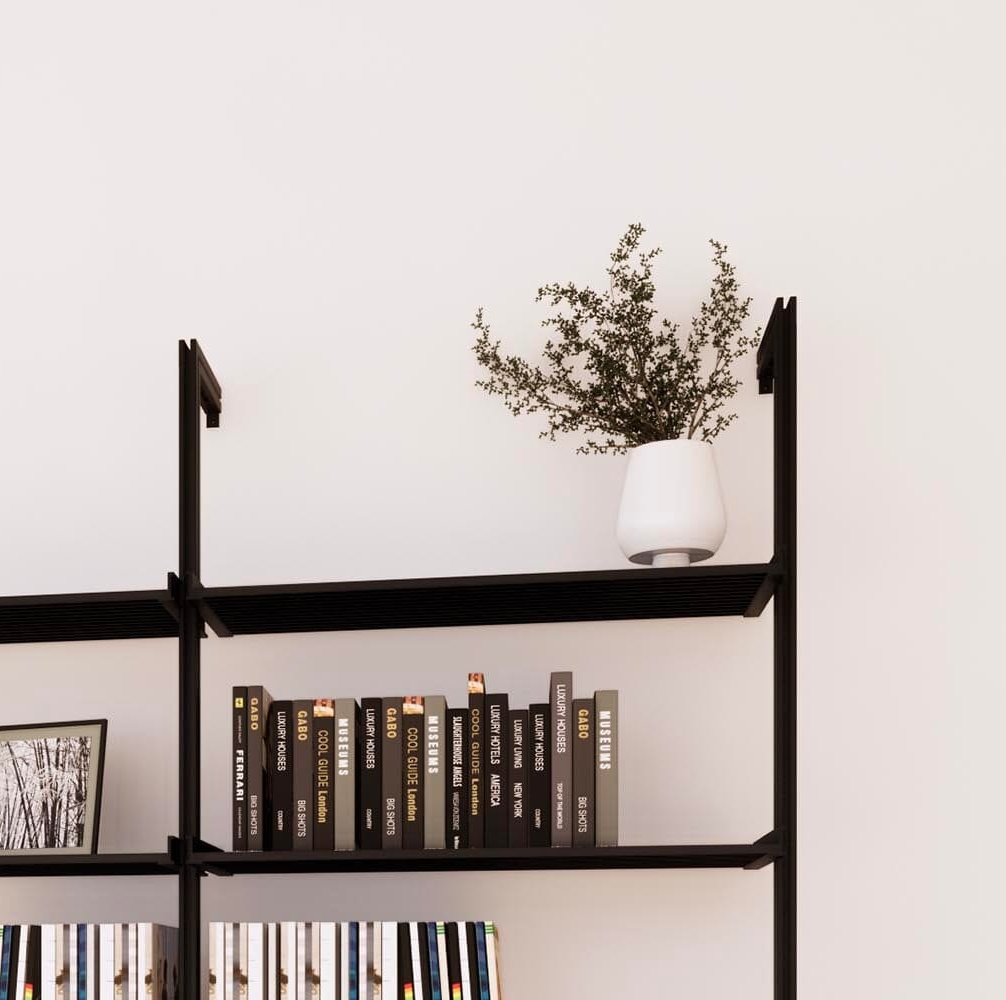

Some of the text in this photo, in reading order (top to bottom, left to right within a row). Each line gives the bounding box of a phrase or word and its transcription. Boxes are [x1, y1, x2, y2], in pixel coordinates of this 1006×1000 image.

[250, 698, 258, 730] GABO
[277, 711, 286, 771] LUXURY HOUSES
[298, 710, 307, 740] GABO
[366, 708, 375, 769] LUXURY HOUSES
[387, 707, 397, 738] GABO
[453, 716, 462, 764] SLAUGHTERHOUSE
[535, 714, 544, 771] LUXURY HOUSES
[557, 684, 566, 753] LUXURY HOUSES
[578, 709, 589, 739] GABO
[600, 711, 611, 769] MUSEUMS
[338, 718, 348, 775] MUSEUMS
[428, 716, 438, 774] MUSEUMS
[472, 708, 480, 815] COOL GUIDE London
[491, 705, 500, 807] LUXURY HOTELS AMERICA
[514, 720, 522, 818] LUXURY LIVING NEW YORK
[236, 750, 244, 800] FERRARI
[318, 730, 328, 822] COOL GUIDE London
[408, 728, 418, 821] COOL GUIDE London
[453, 766, 462, 787] ANGELS
[250, 795, 258, 835] BIG SHOTS
[298, 800, 306, 837] BIG SHOTS
[387, 798, 395, 836] BIG SHOTS
[578, 797, 586, 832] BIG SHOTS
